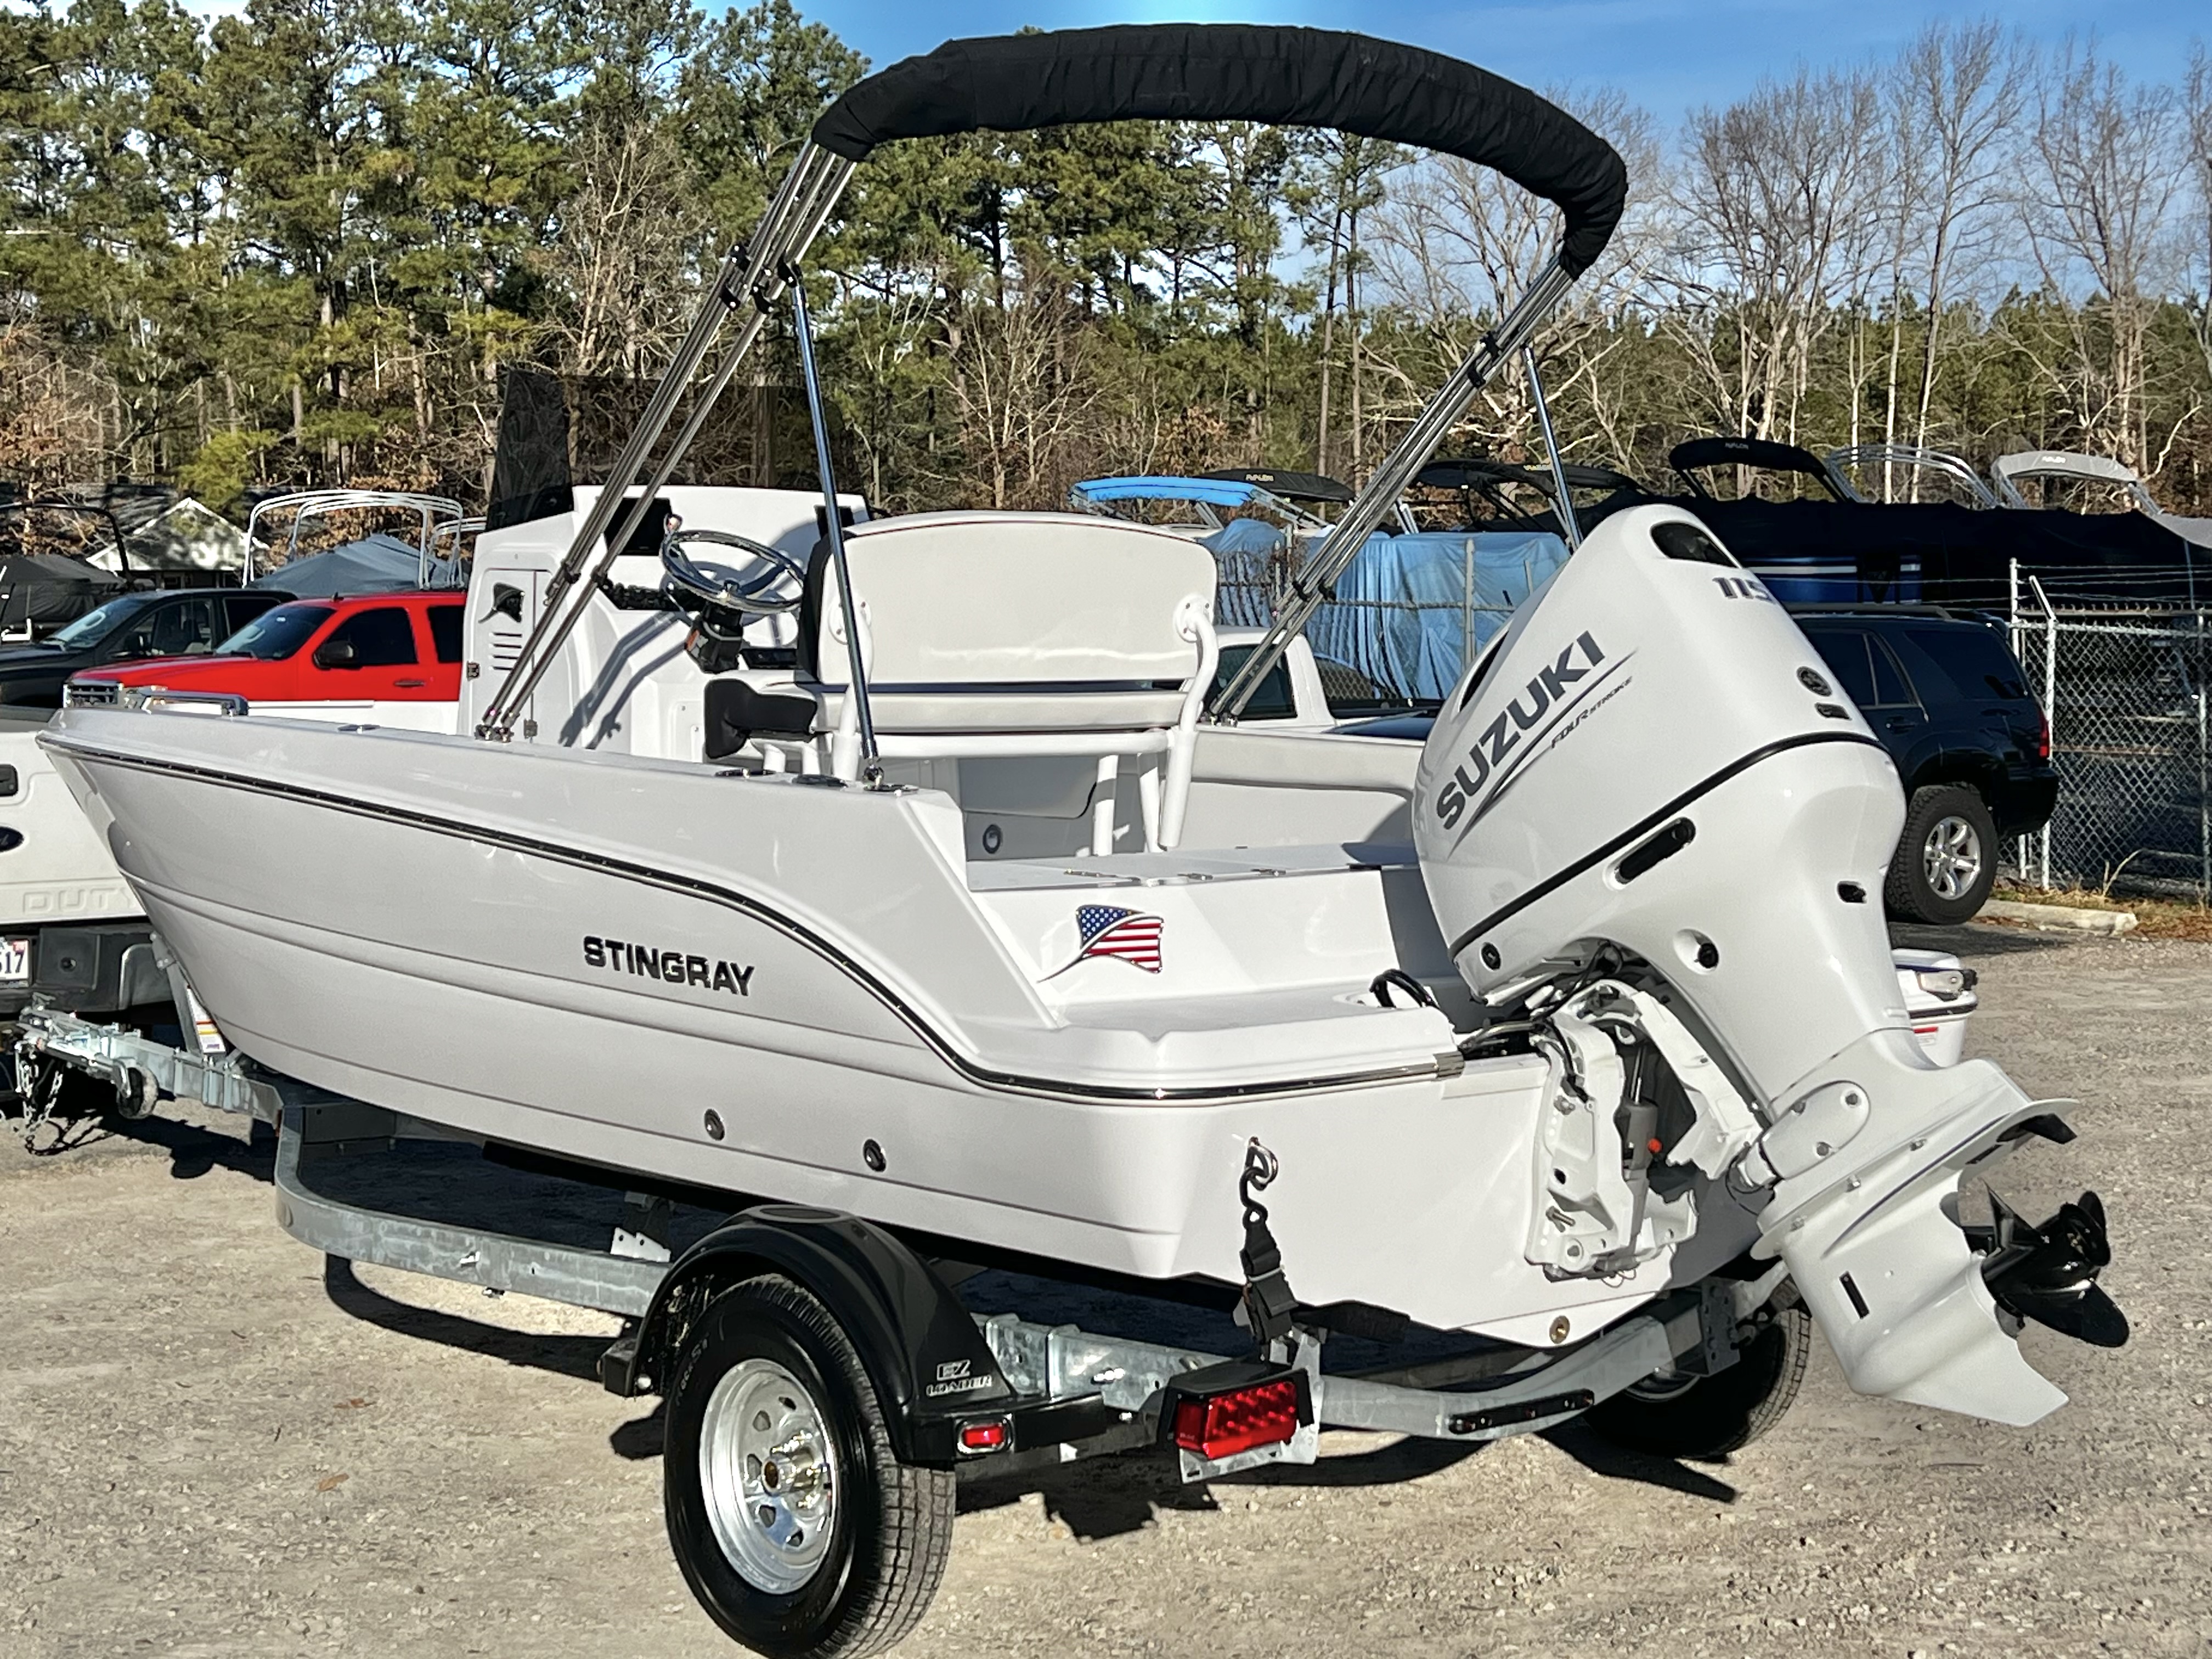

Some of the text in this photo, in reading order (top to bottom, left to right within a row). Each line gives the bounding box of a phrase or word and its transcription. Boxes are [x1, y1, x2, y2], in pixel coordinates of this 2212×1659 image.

[1712, 577, 1776, 604] 115
[1436, 630, 1605, 830] SUZUKI
[1551, 709, 1588, 748] FOUR
[584, 936, 755, 996] STINGRAY
[936, 1359, 970, 1381] EZ
